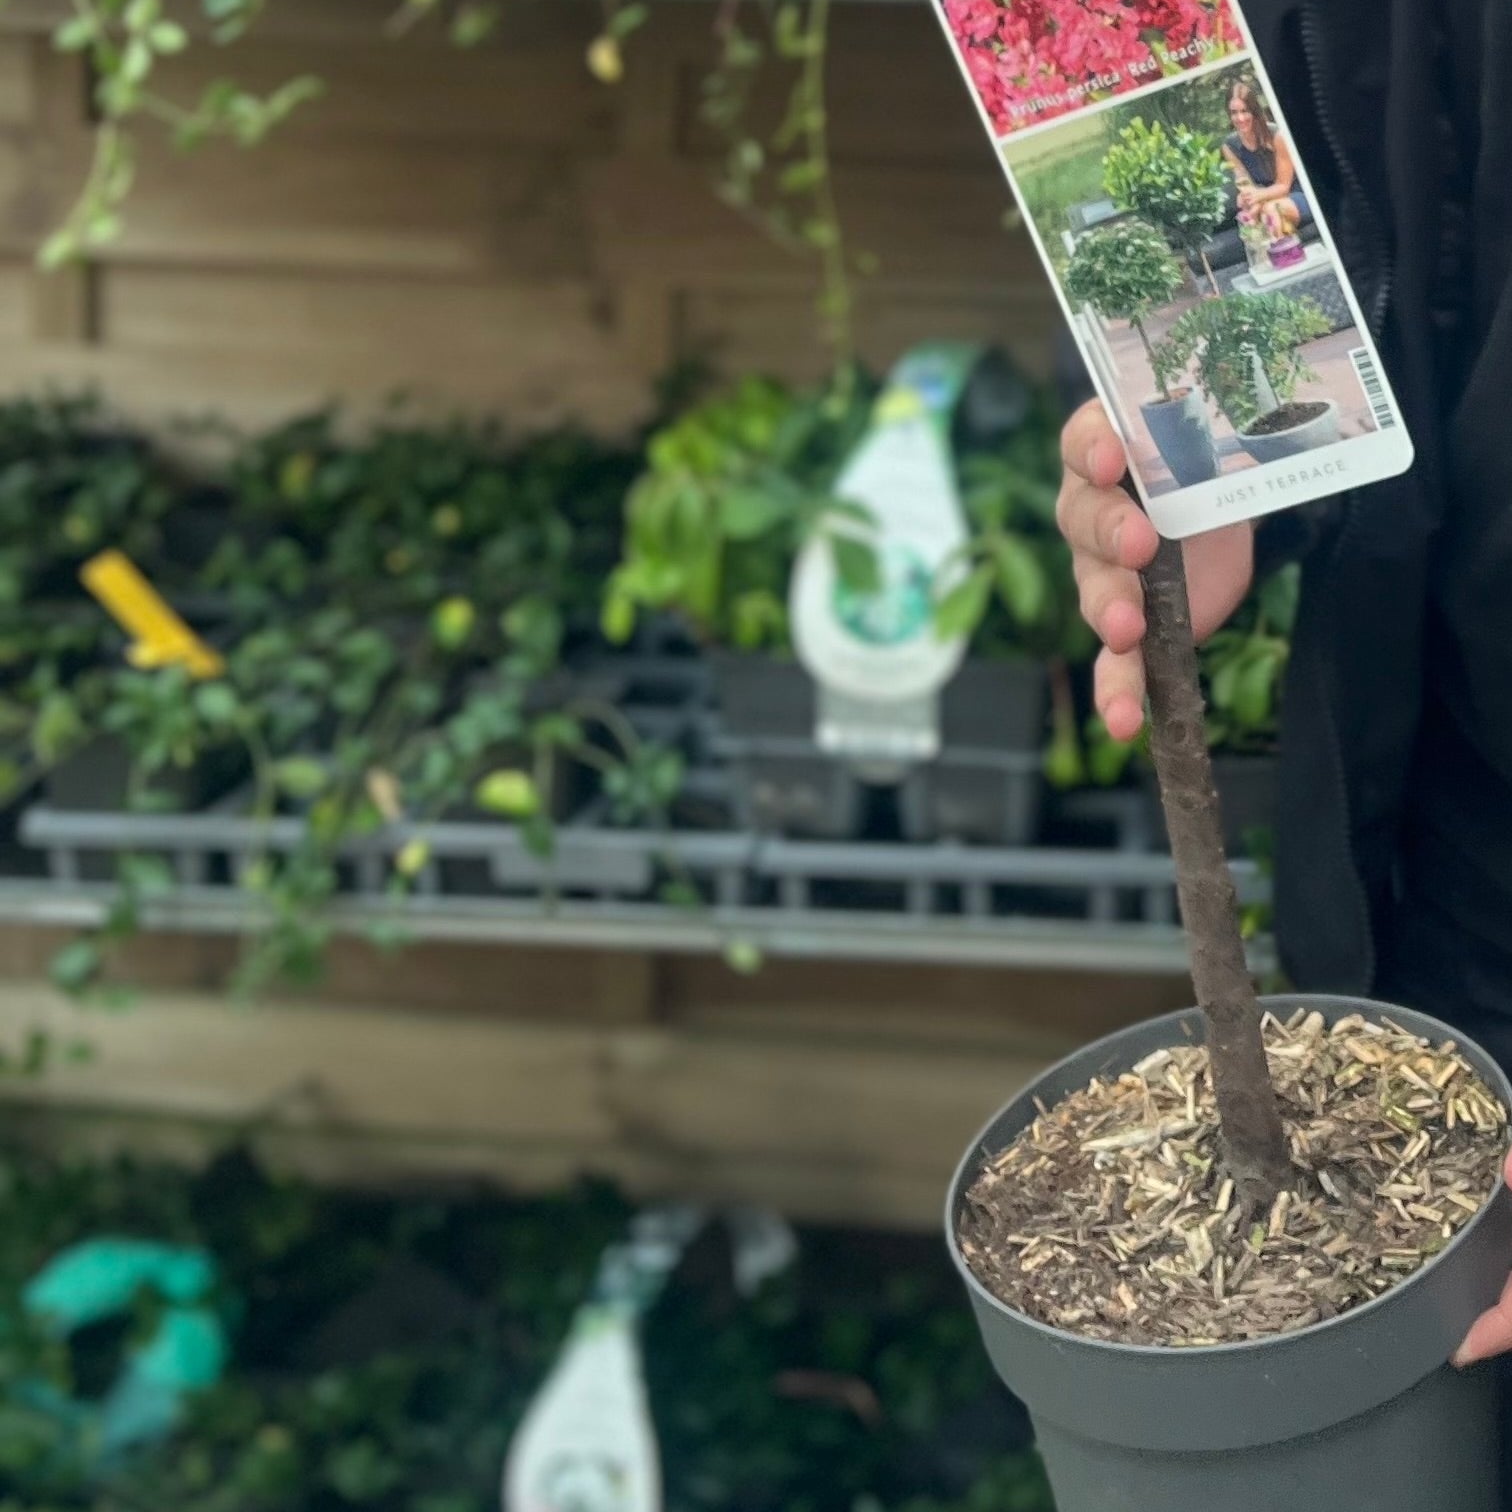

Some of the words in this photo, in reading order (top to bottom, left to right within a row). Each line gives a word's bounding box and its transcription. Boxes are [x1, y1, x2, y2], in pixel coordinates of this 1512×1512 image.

[1009, 93, 1064, 117] Prunus
[1066, 72, 1121, 102] persica
[1216, 486, 1257, 508] JUST
[1265, 460, 1347, 492] TERRACE
